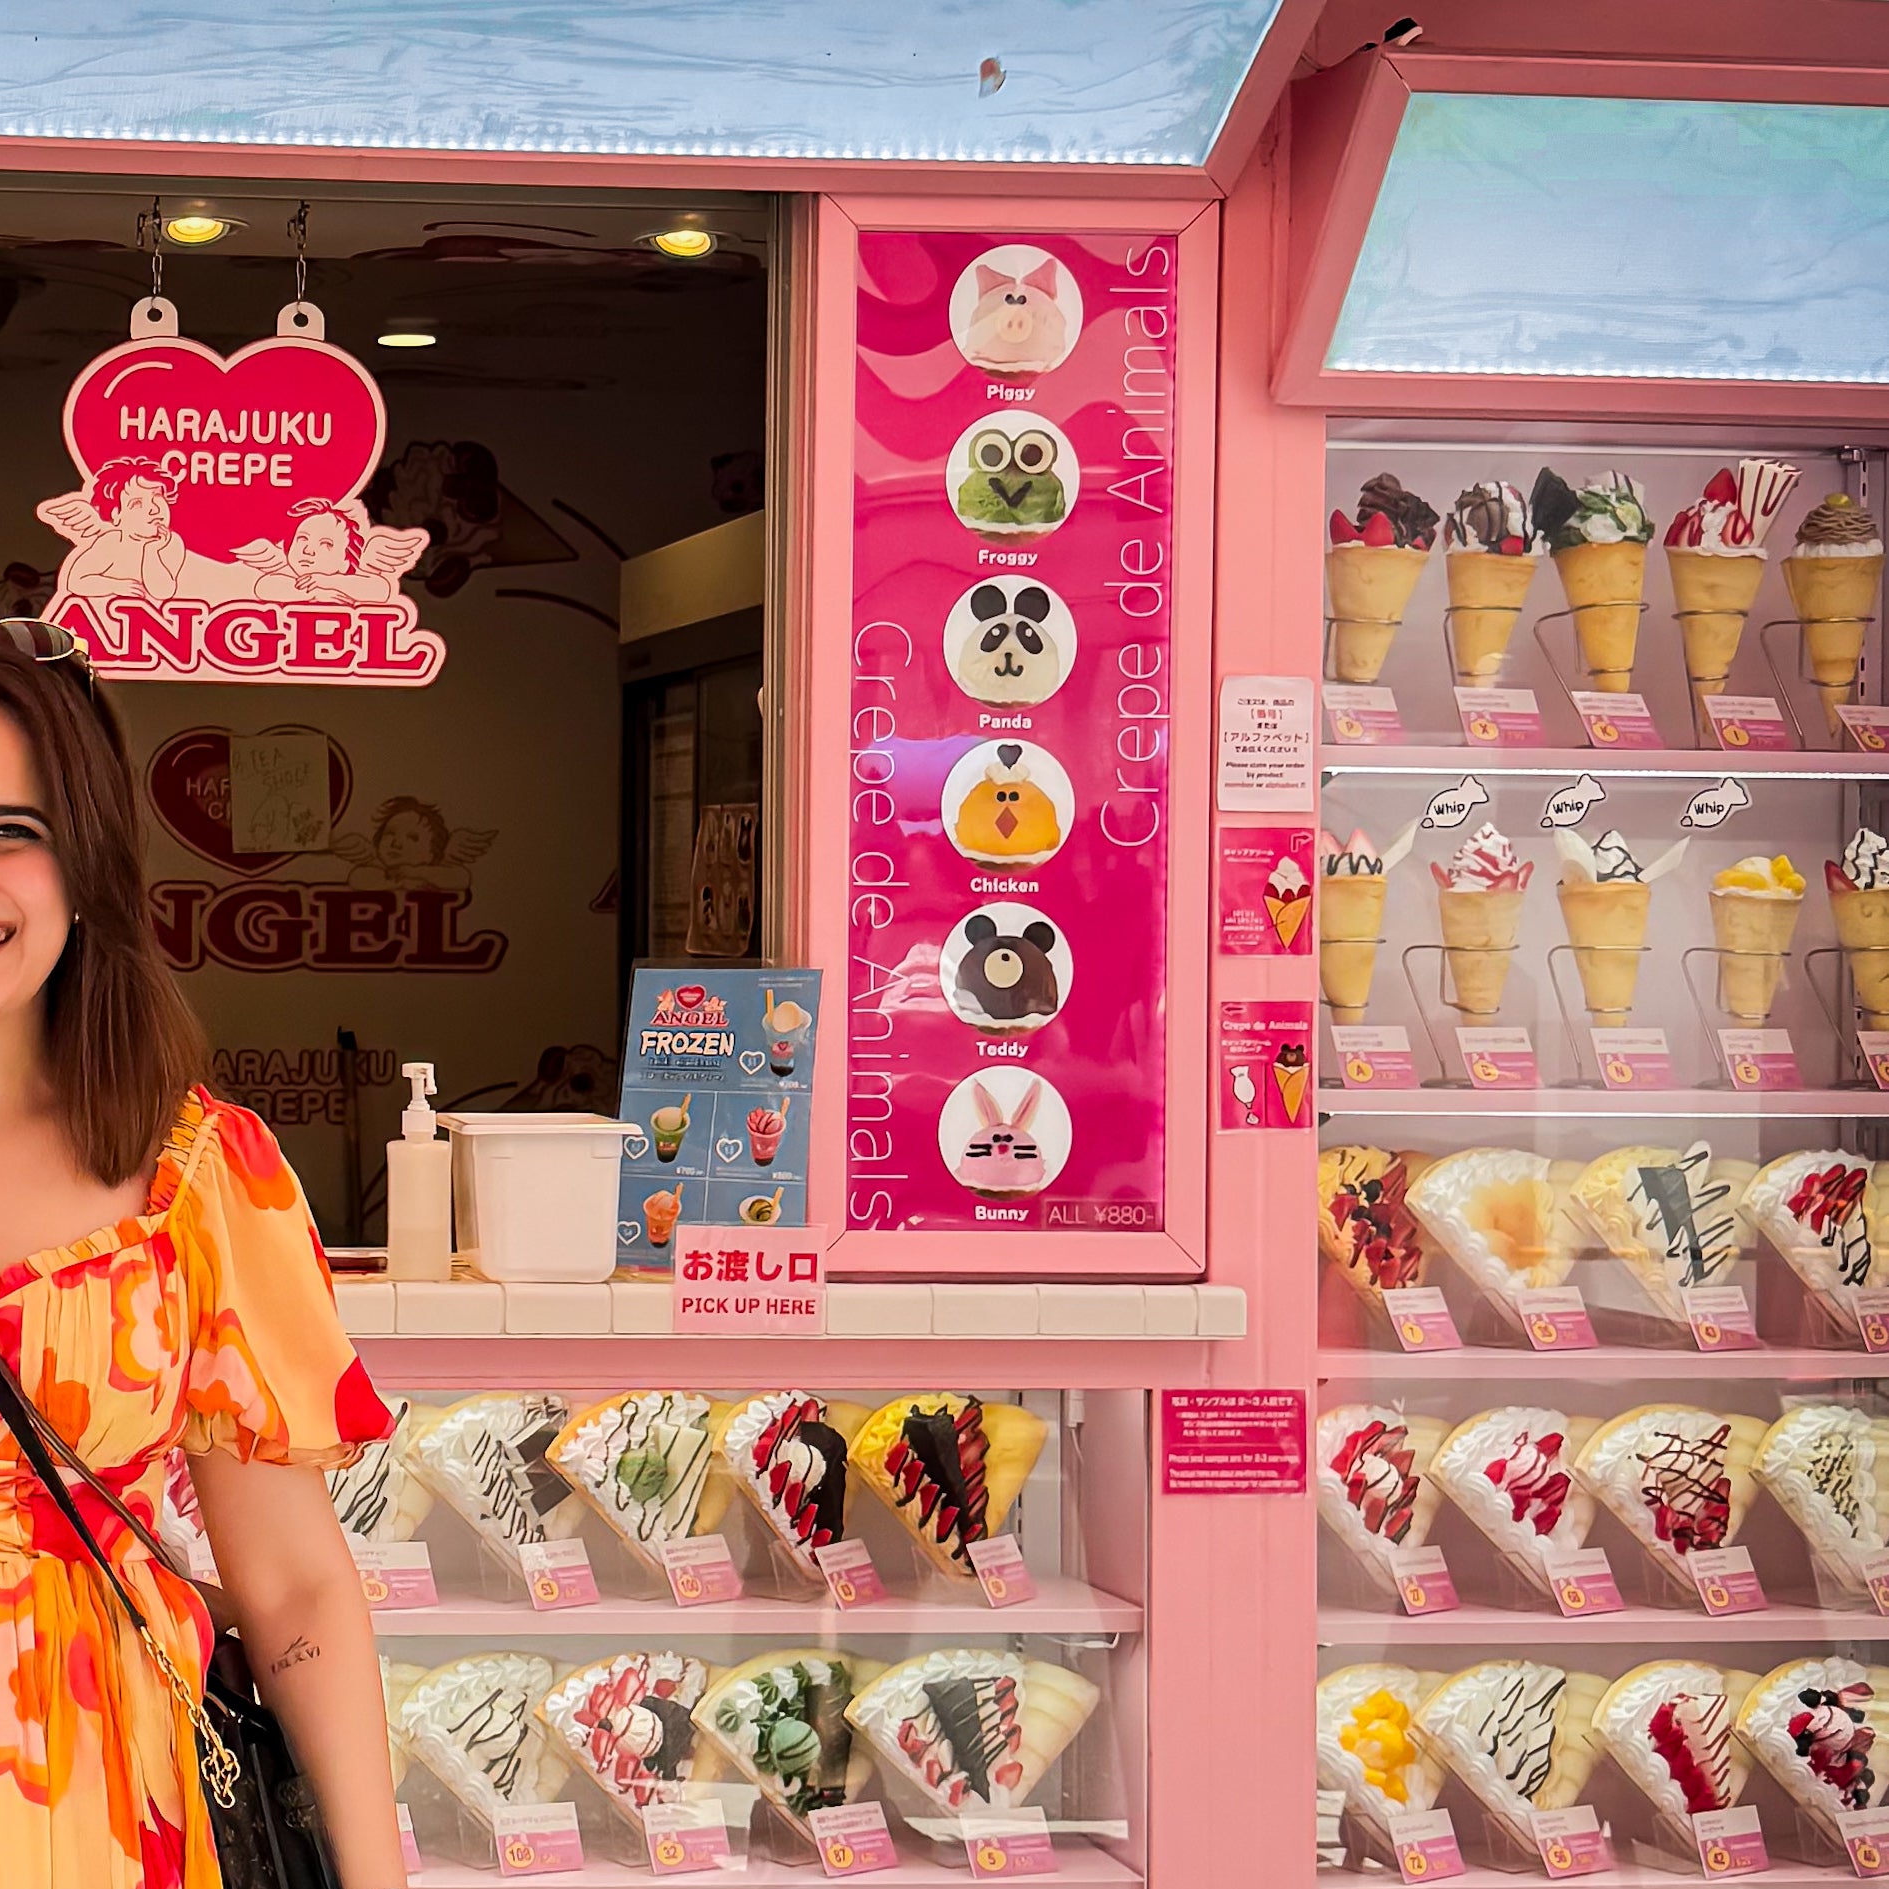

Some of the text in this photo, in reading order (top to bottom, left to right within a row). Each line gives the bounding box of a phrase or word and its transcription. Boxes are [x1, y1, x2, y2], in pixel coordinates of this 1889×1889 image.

[1106, 245, 1169, 514] Animals
[986, 383, 1035, 402] Piggy
[119, 404, 332, 447] HARAJUKU
[161, 449, 293, 487] CREPE
[978, 549, 1038, 567] Froggy
[1103, 538, 1165, 618] de
[51, 597, 438, 679] ANGEL
[851, 620, 913, 825] Crepe
[978, 713, 1032, 730] Panda
[1100, 641, 1169, 848] Crepe
[1433, 801, 1466, 817] Whip
[1551, 800, 1585, 815] Whip
[1693, 801, 1726, 816] Whip
[850, 851, 910, 929] de
[970, 877, 1039, 894] Chicken
[149, 880, 509, 974] NGEL
[650, 1010, 730, 1027] ANGEL
[639, 1030, 736, 1057] FROZEN
[976, 1041, 1029, 1059] Teddy
[212, 1048, 397, 1087] ARAJUKU
[1355, 1064, 1366, 1076] A
[849, 954, 911, 1223] Animals
[244, 1089, 347, 1125] REPE
[975, 1205, 1029, 1223] Bunny
[1048, 1206, 1086, 1224] ALL
[682, 1249, 818, 1283] お渡し口
[681, 1297, 816, 1316] PICK UP HERE
[833, 1848, 847, 1863] 87
[987, 1853, 996, 1866] 5
